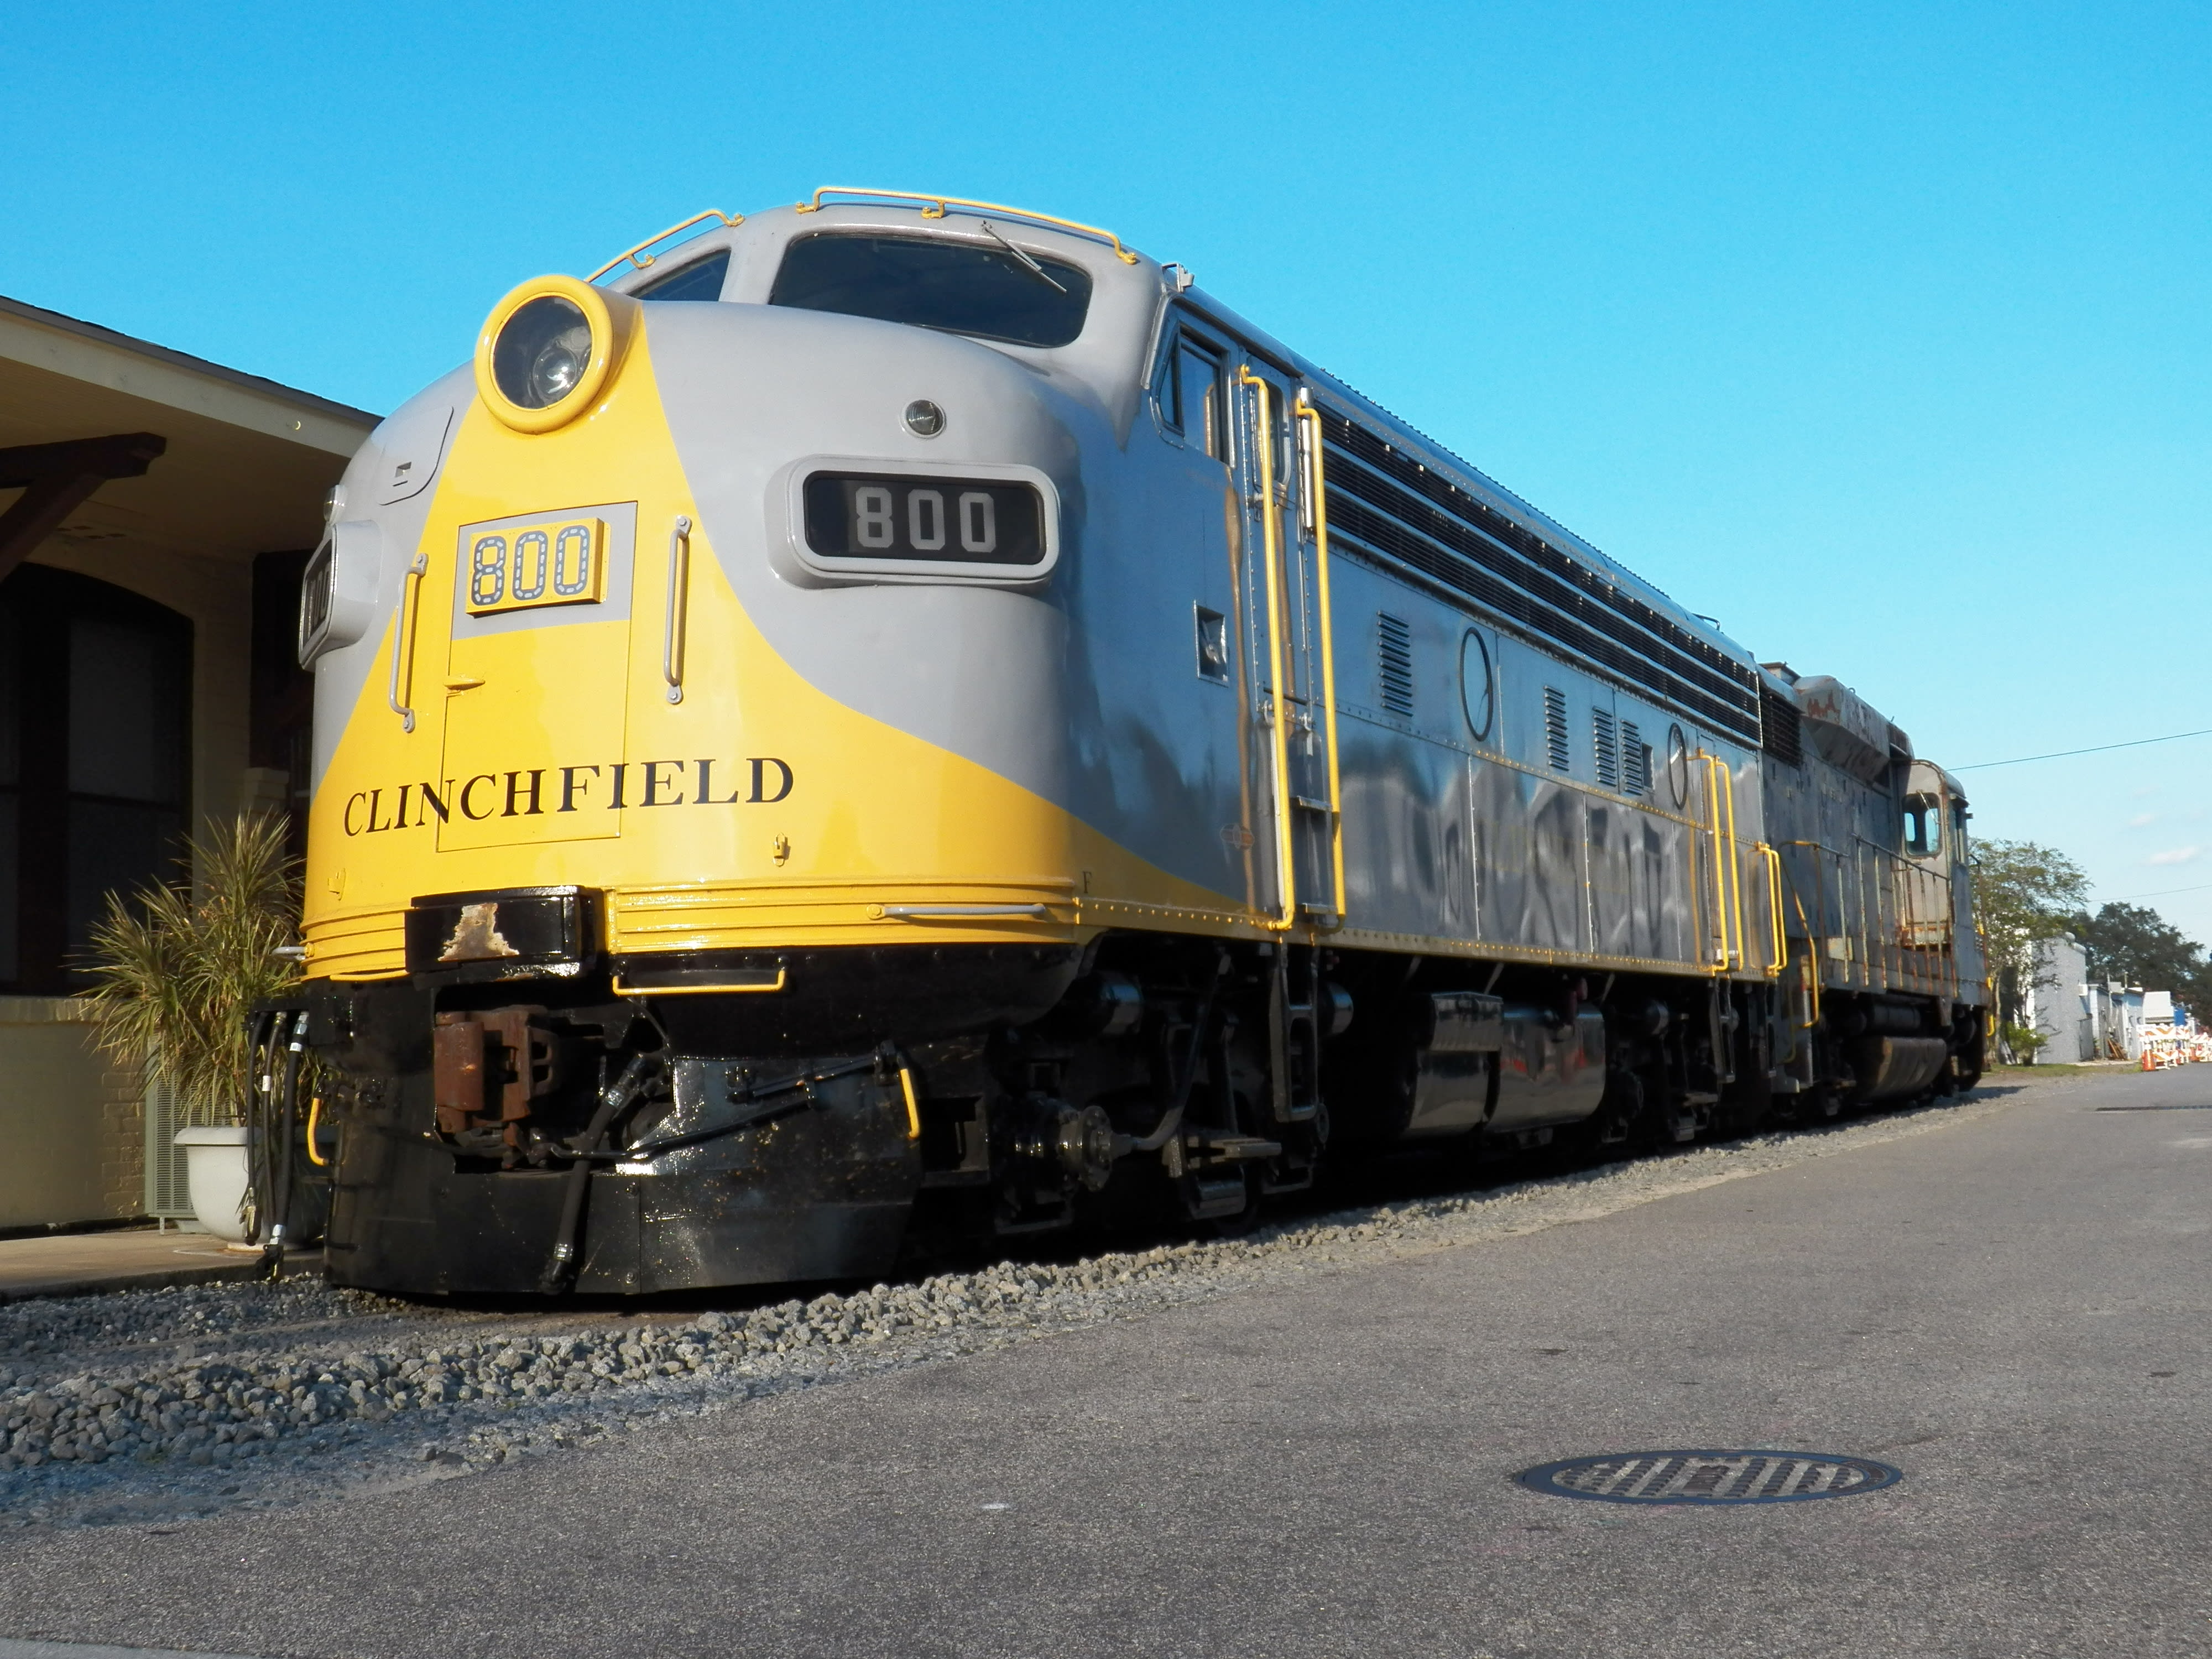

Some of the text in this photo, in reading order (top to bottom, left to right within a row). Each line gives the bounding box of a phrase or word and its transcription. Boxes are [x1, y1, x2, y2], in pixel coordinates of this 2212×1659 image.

[855, 487, 996, 553] 800
[471, 525, 590, 606] 800
[344, 758, 794, 837] CLINCHFIELD
[1082, 871, 1093, 894] F
